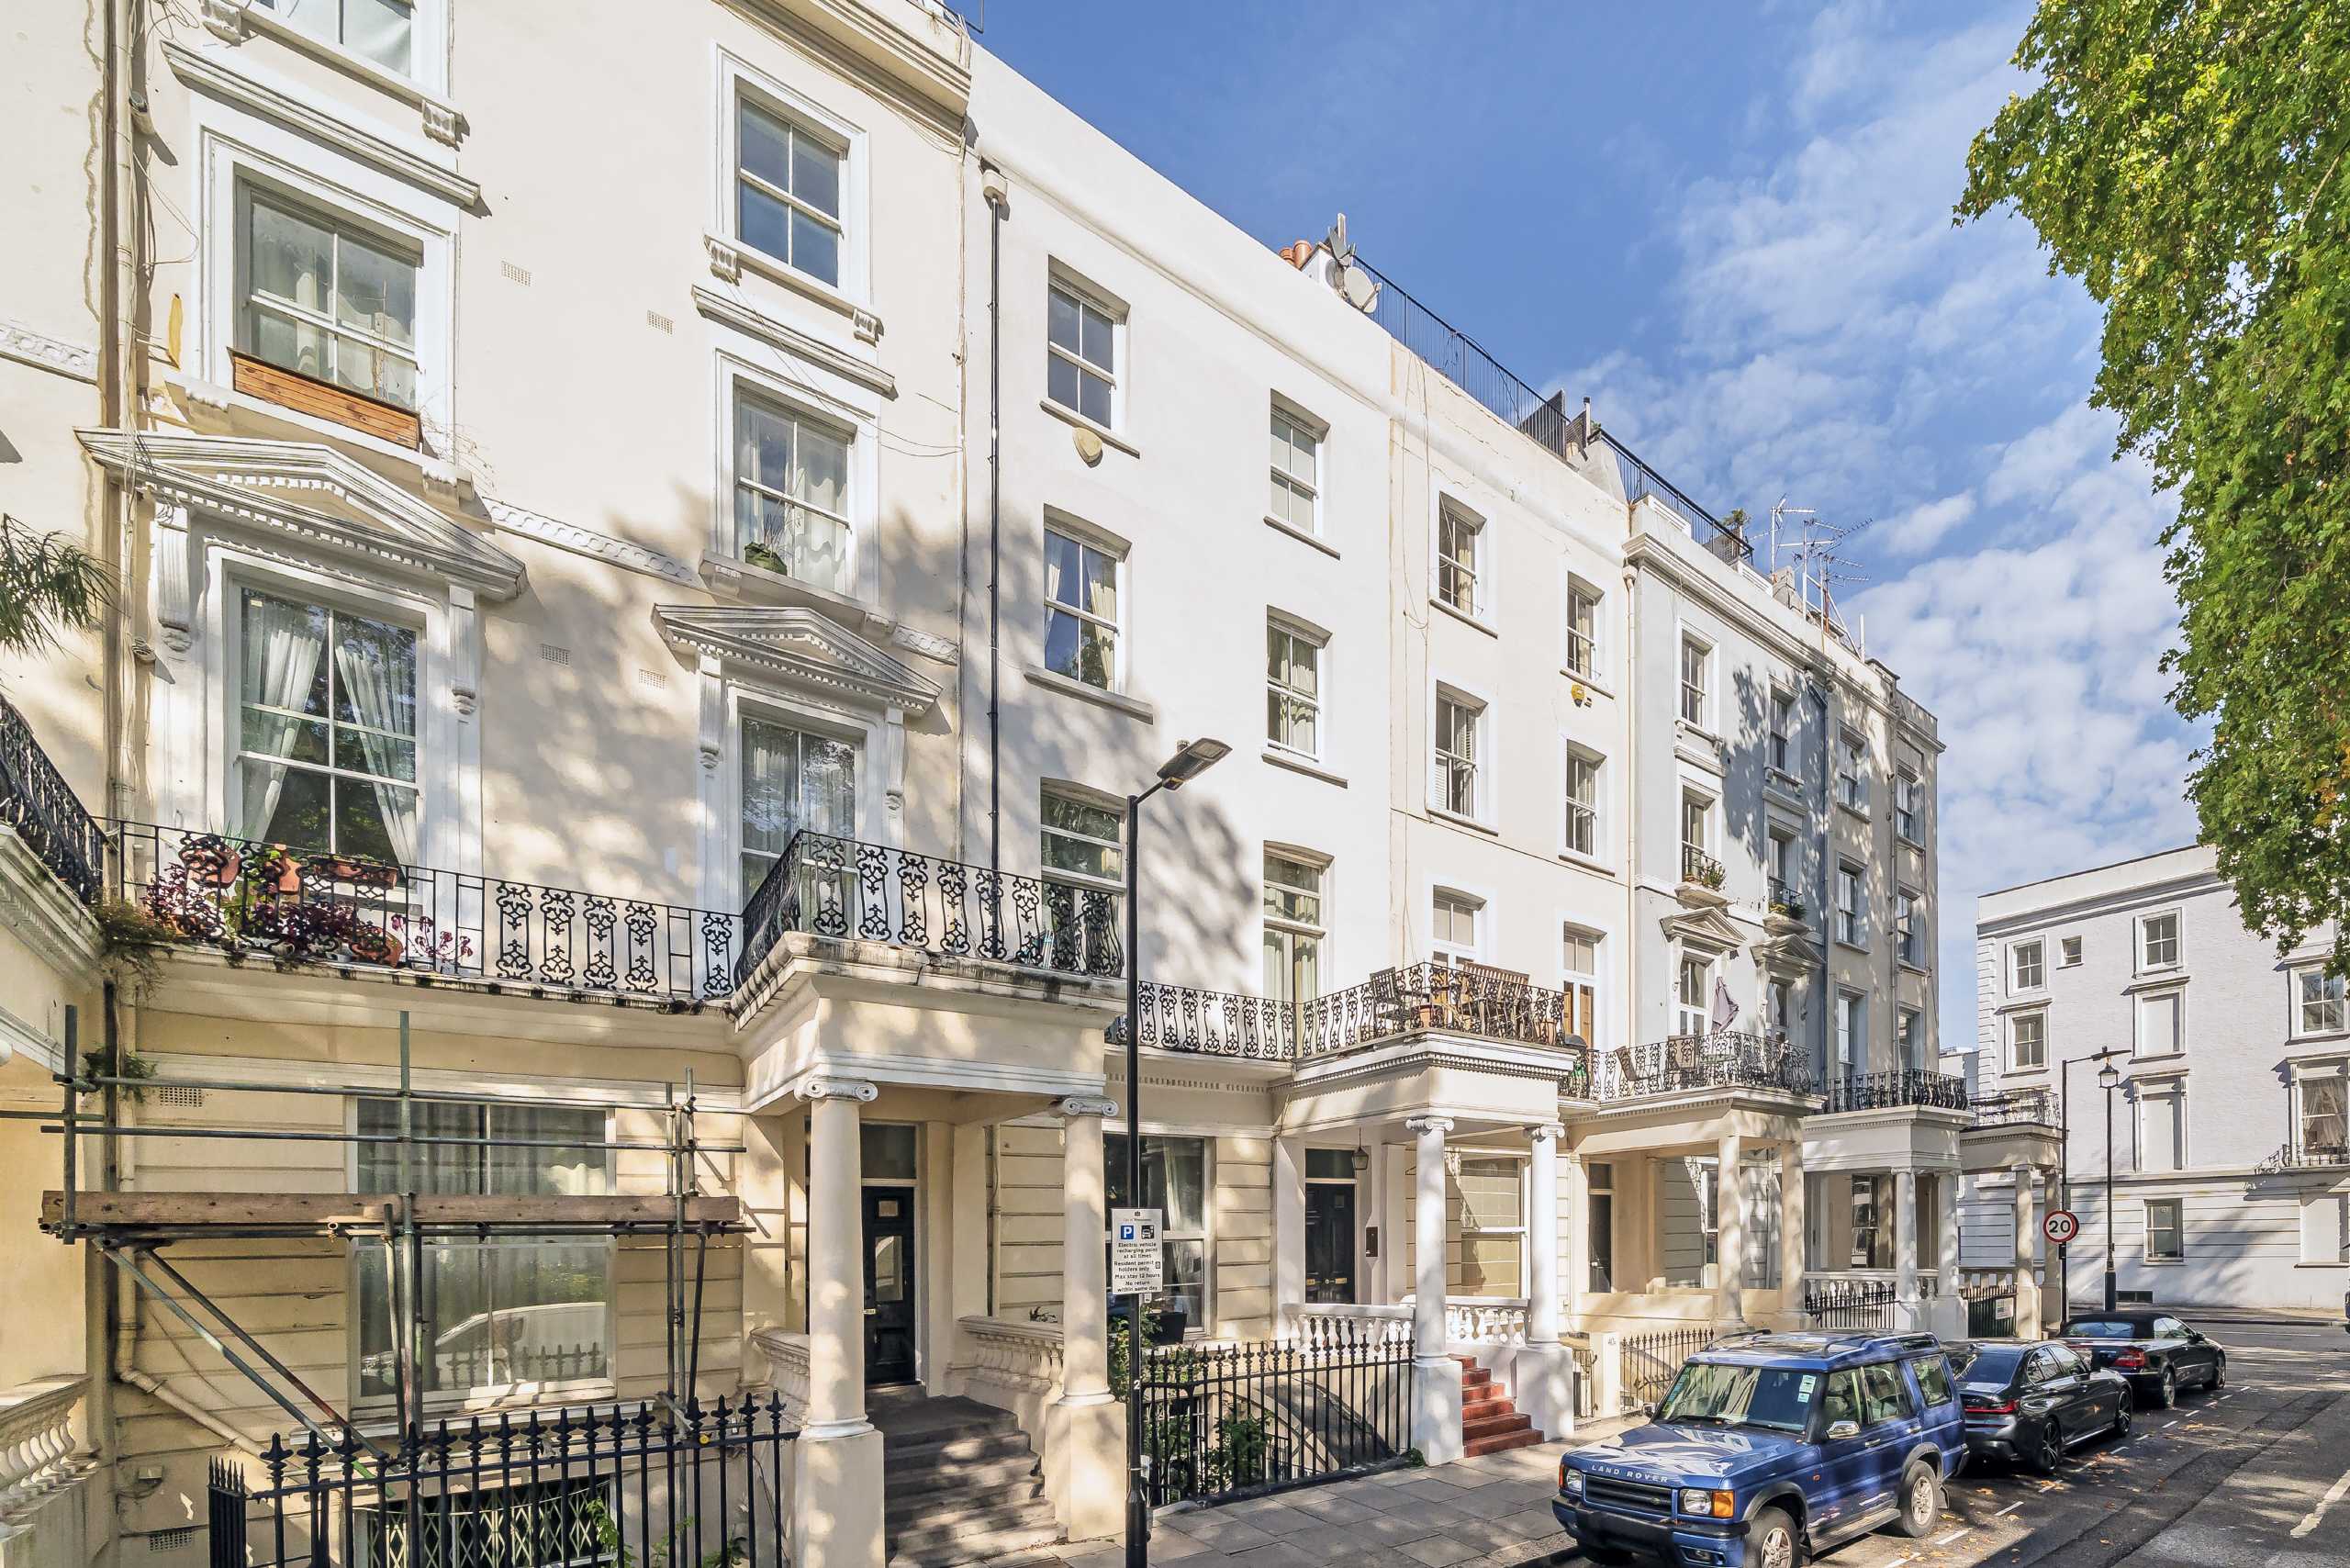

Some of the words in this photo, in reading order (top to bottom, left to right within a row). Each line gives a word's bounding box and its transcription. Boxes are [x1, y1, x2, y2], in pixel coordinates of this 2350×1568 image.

[1124, 1226, 1133, 1238] P
[2048, 1219, 2071, 1234] 20
[1133, 1379, 1141, 1391] 2
[1591, 1464, 1620, 1475] LAND
[1626, 1471, 1668, 1483] ROVER
